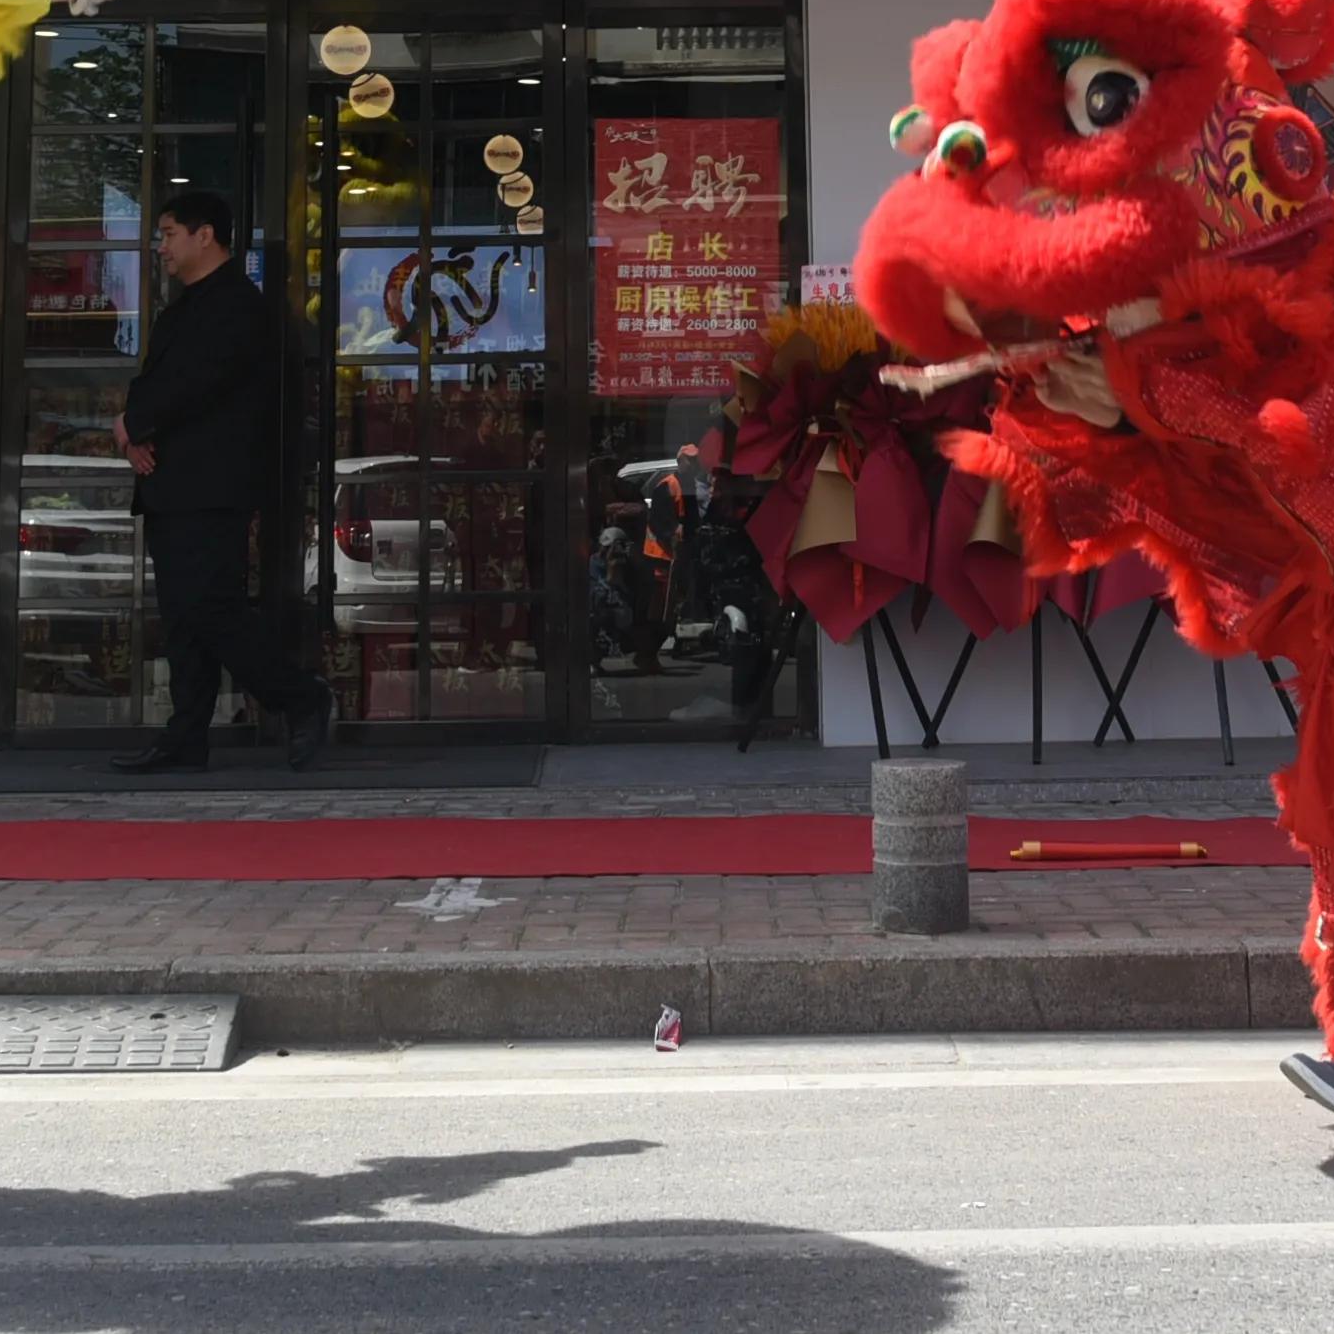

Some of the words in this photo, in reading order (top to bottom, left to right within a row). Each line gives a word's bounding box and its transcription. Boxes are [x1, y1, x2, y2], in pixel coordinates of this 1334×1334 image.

[603, 151, 761, 218] 招聘
[615, 285, 759, 314] 厨房操作工
